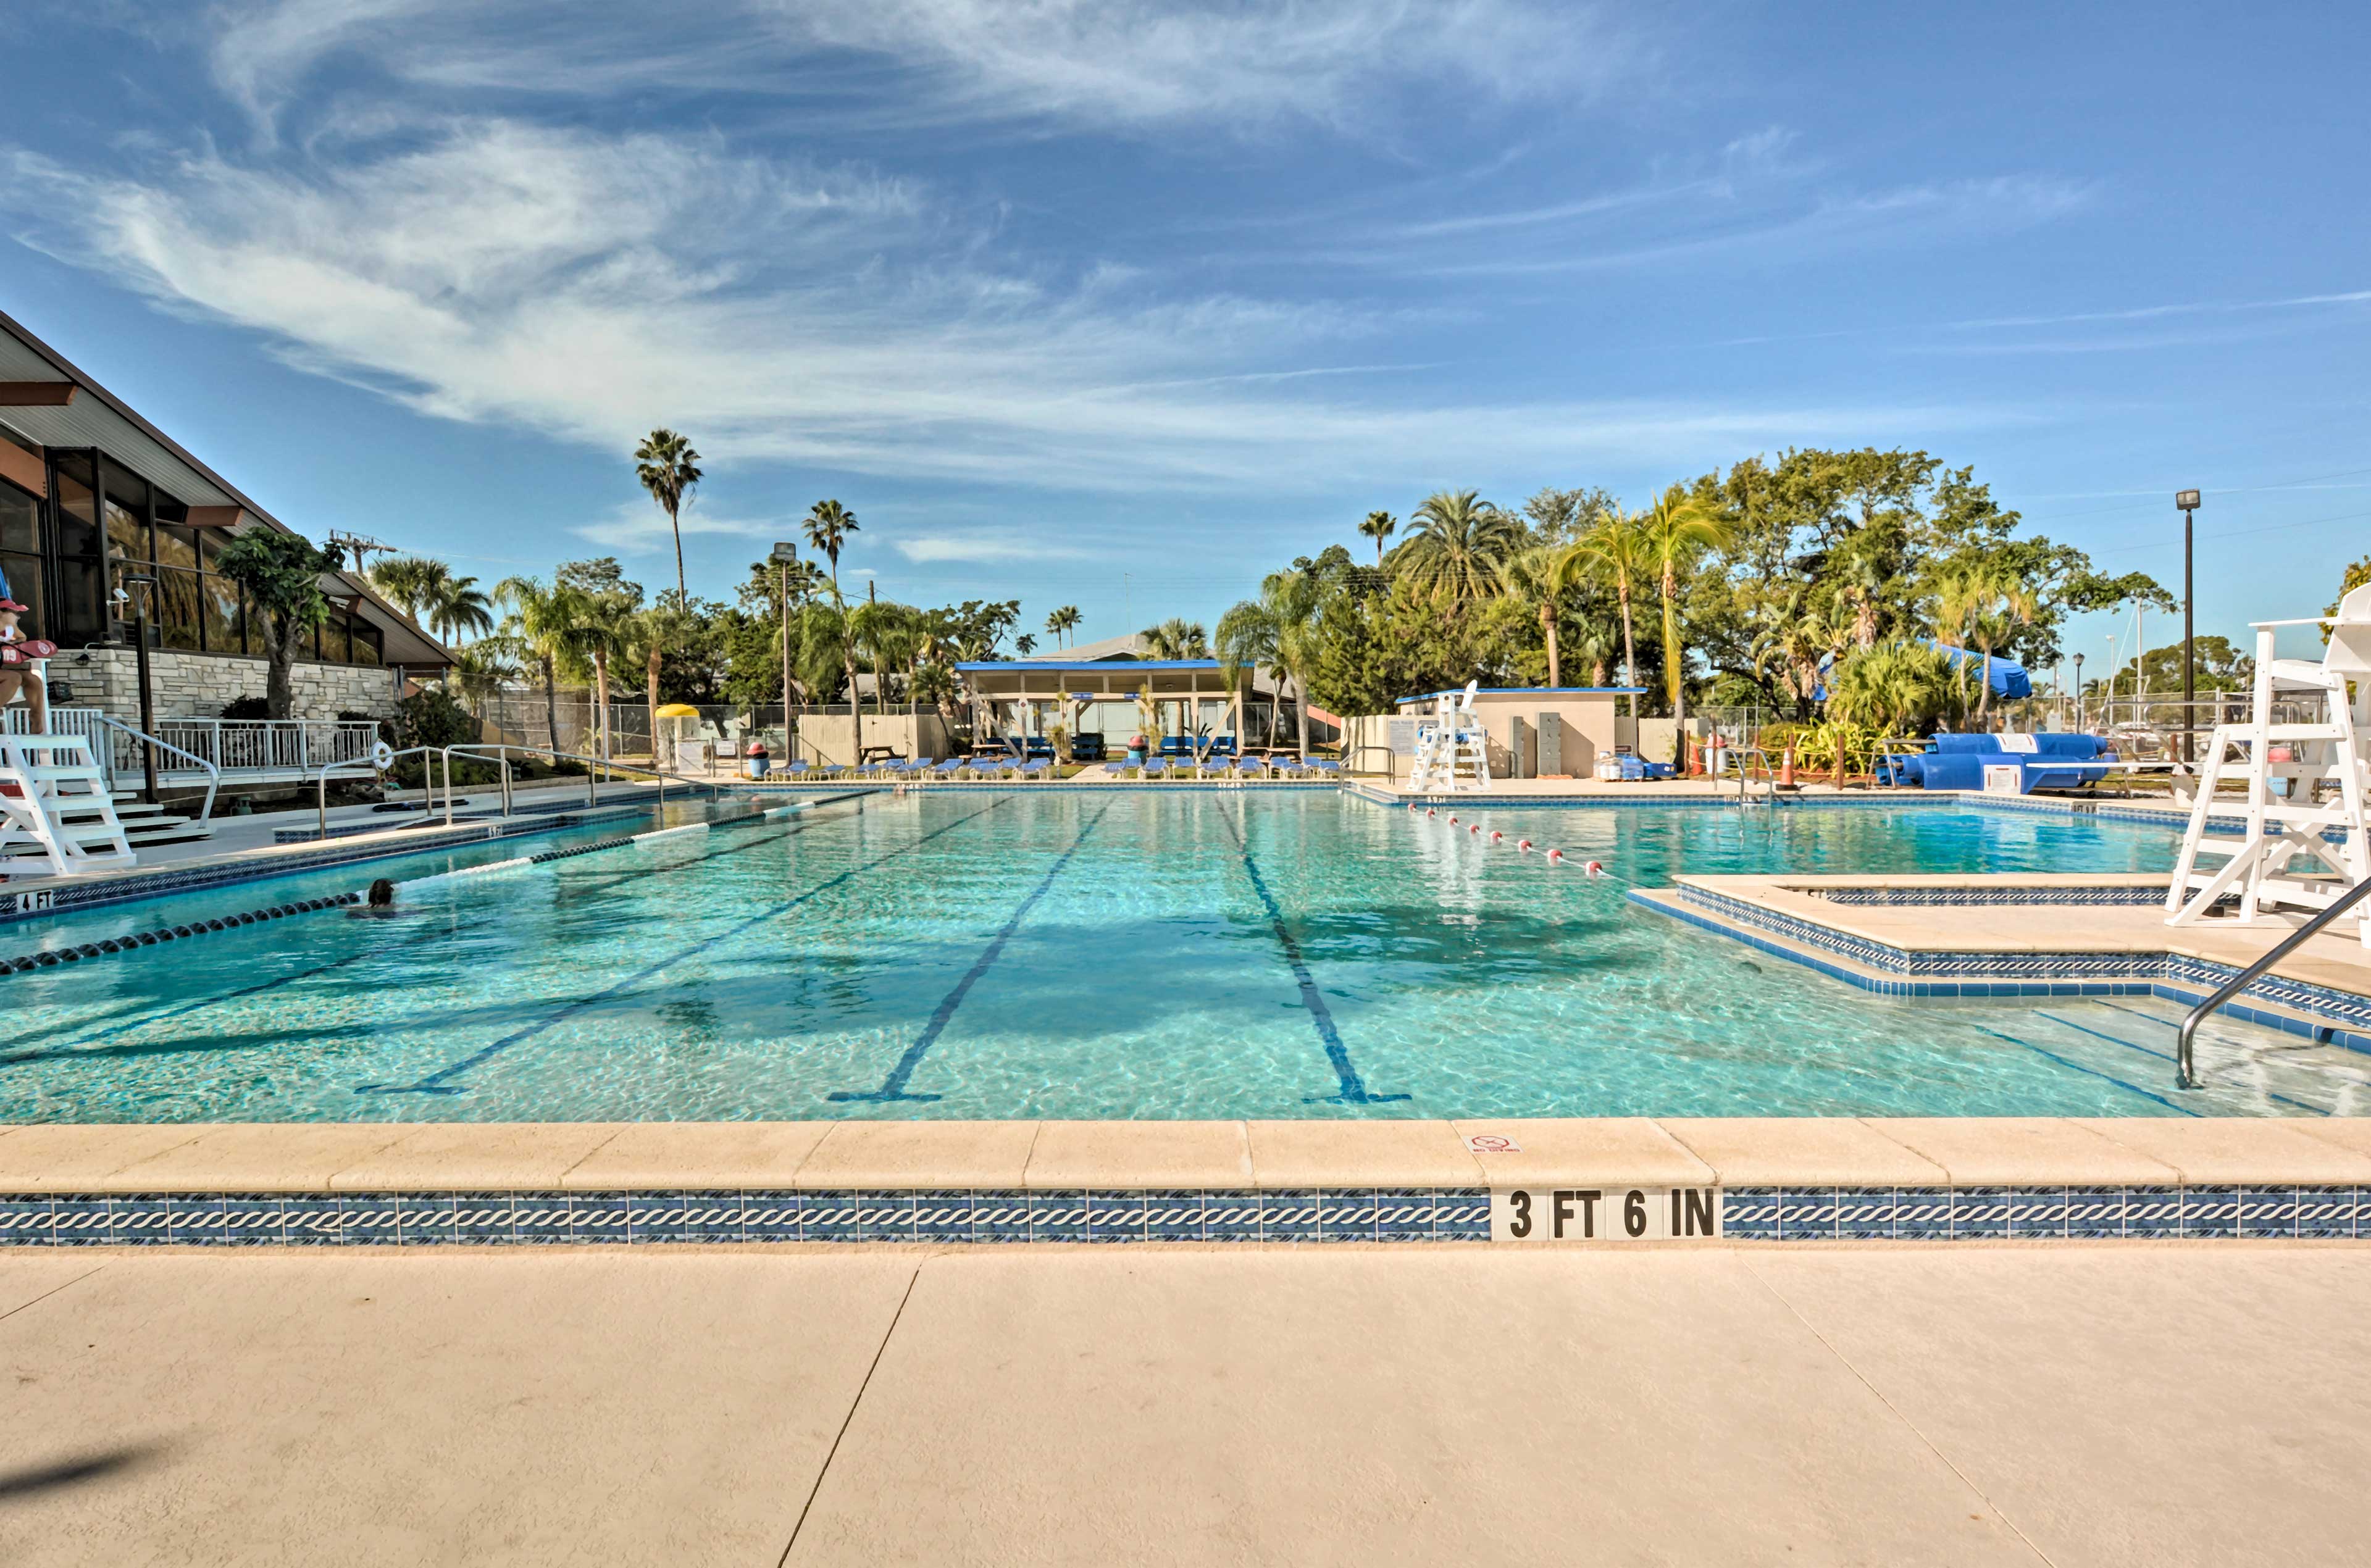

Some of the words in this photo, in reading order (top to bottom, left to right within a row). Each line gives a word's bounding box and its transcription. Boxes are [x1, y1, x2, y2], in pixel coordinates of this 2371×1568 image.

[23, 894, 30, 911] 4
[37, 891, 51, 909] FT
[1510, 1190, 1532, 1238] 3
[1553, 1190, 1601, 1238] FT
[1625, 1190, 1646, 1237] 6
[1671, 1189, 1713, 1236] IN
